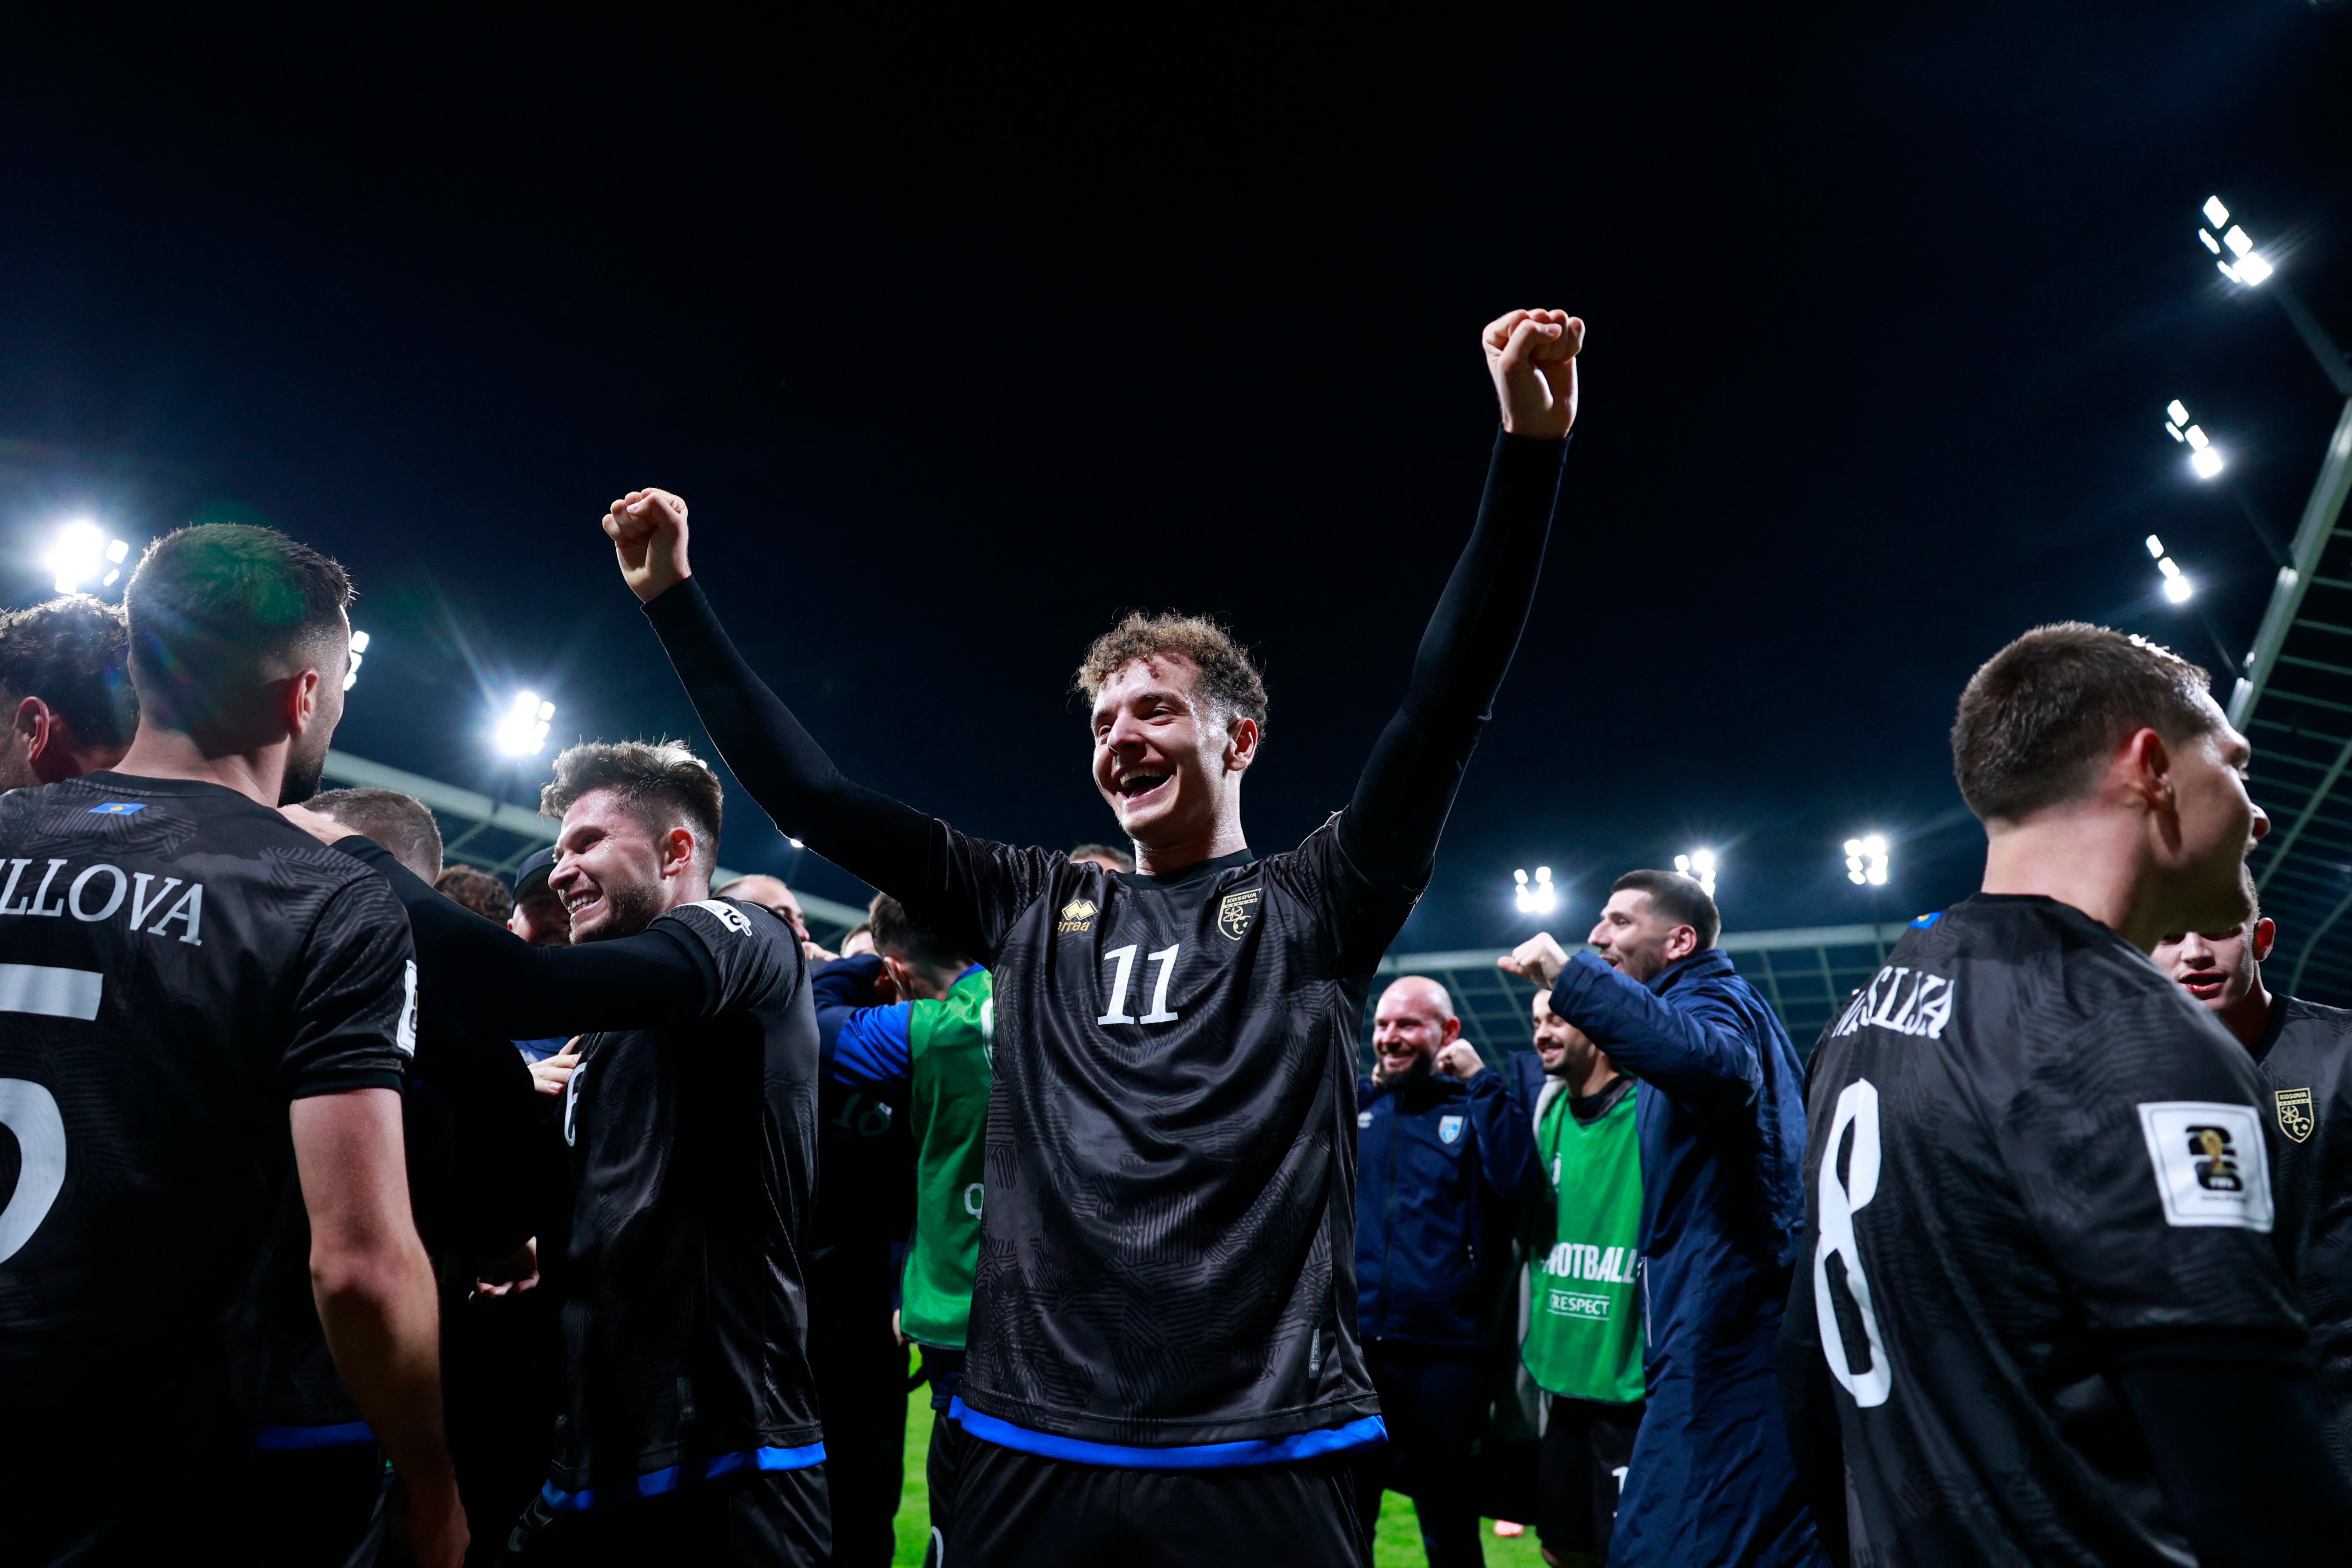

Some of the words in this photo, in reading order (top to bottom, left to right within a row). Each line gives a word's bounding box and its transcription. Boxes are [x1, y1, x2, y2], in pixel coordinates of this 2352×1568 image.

[0, 859, 203, 946] LLOVA
[1227, 892, 1257, 903] KOSOVA
[1097, 944, 1179, 1025] 11
[2279, 1092, 2308, 1100] KOSOVA
[1814, 1077, 1892, 1408] 8
[1550, 1294, 1610, 1315] RESPECT
